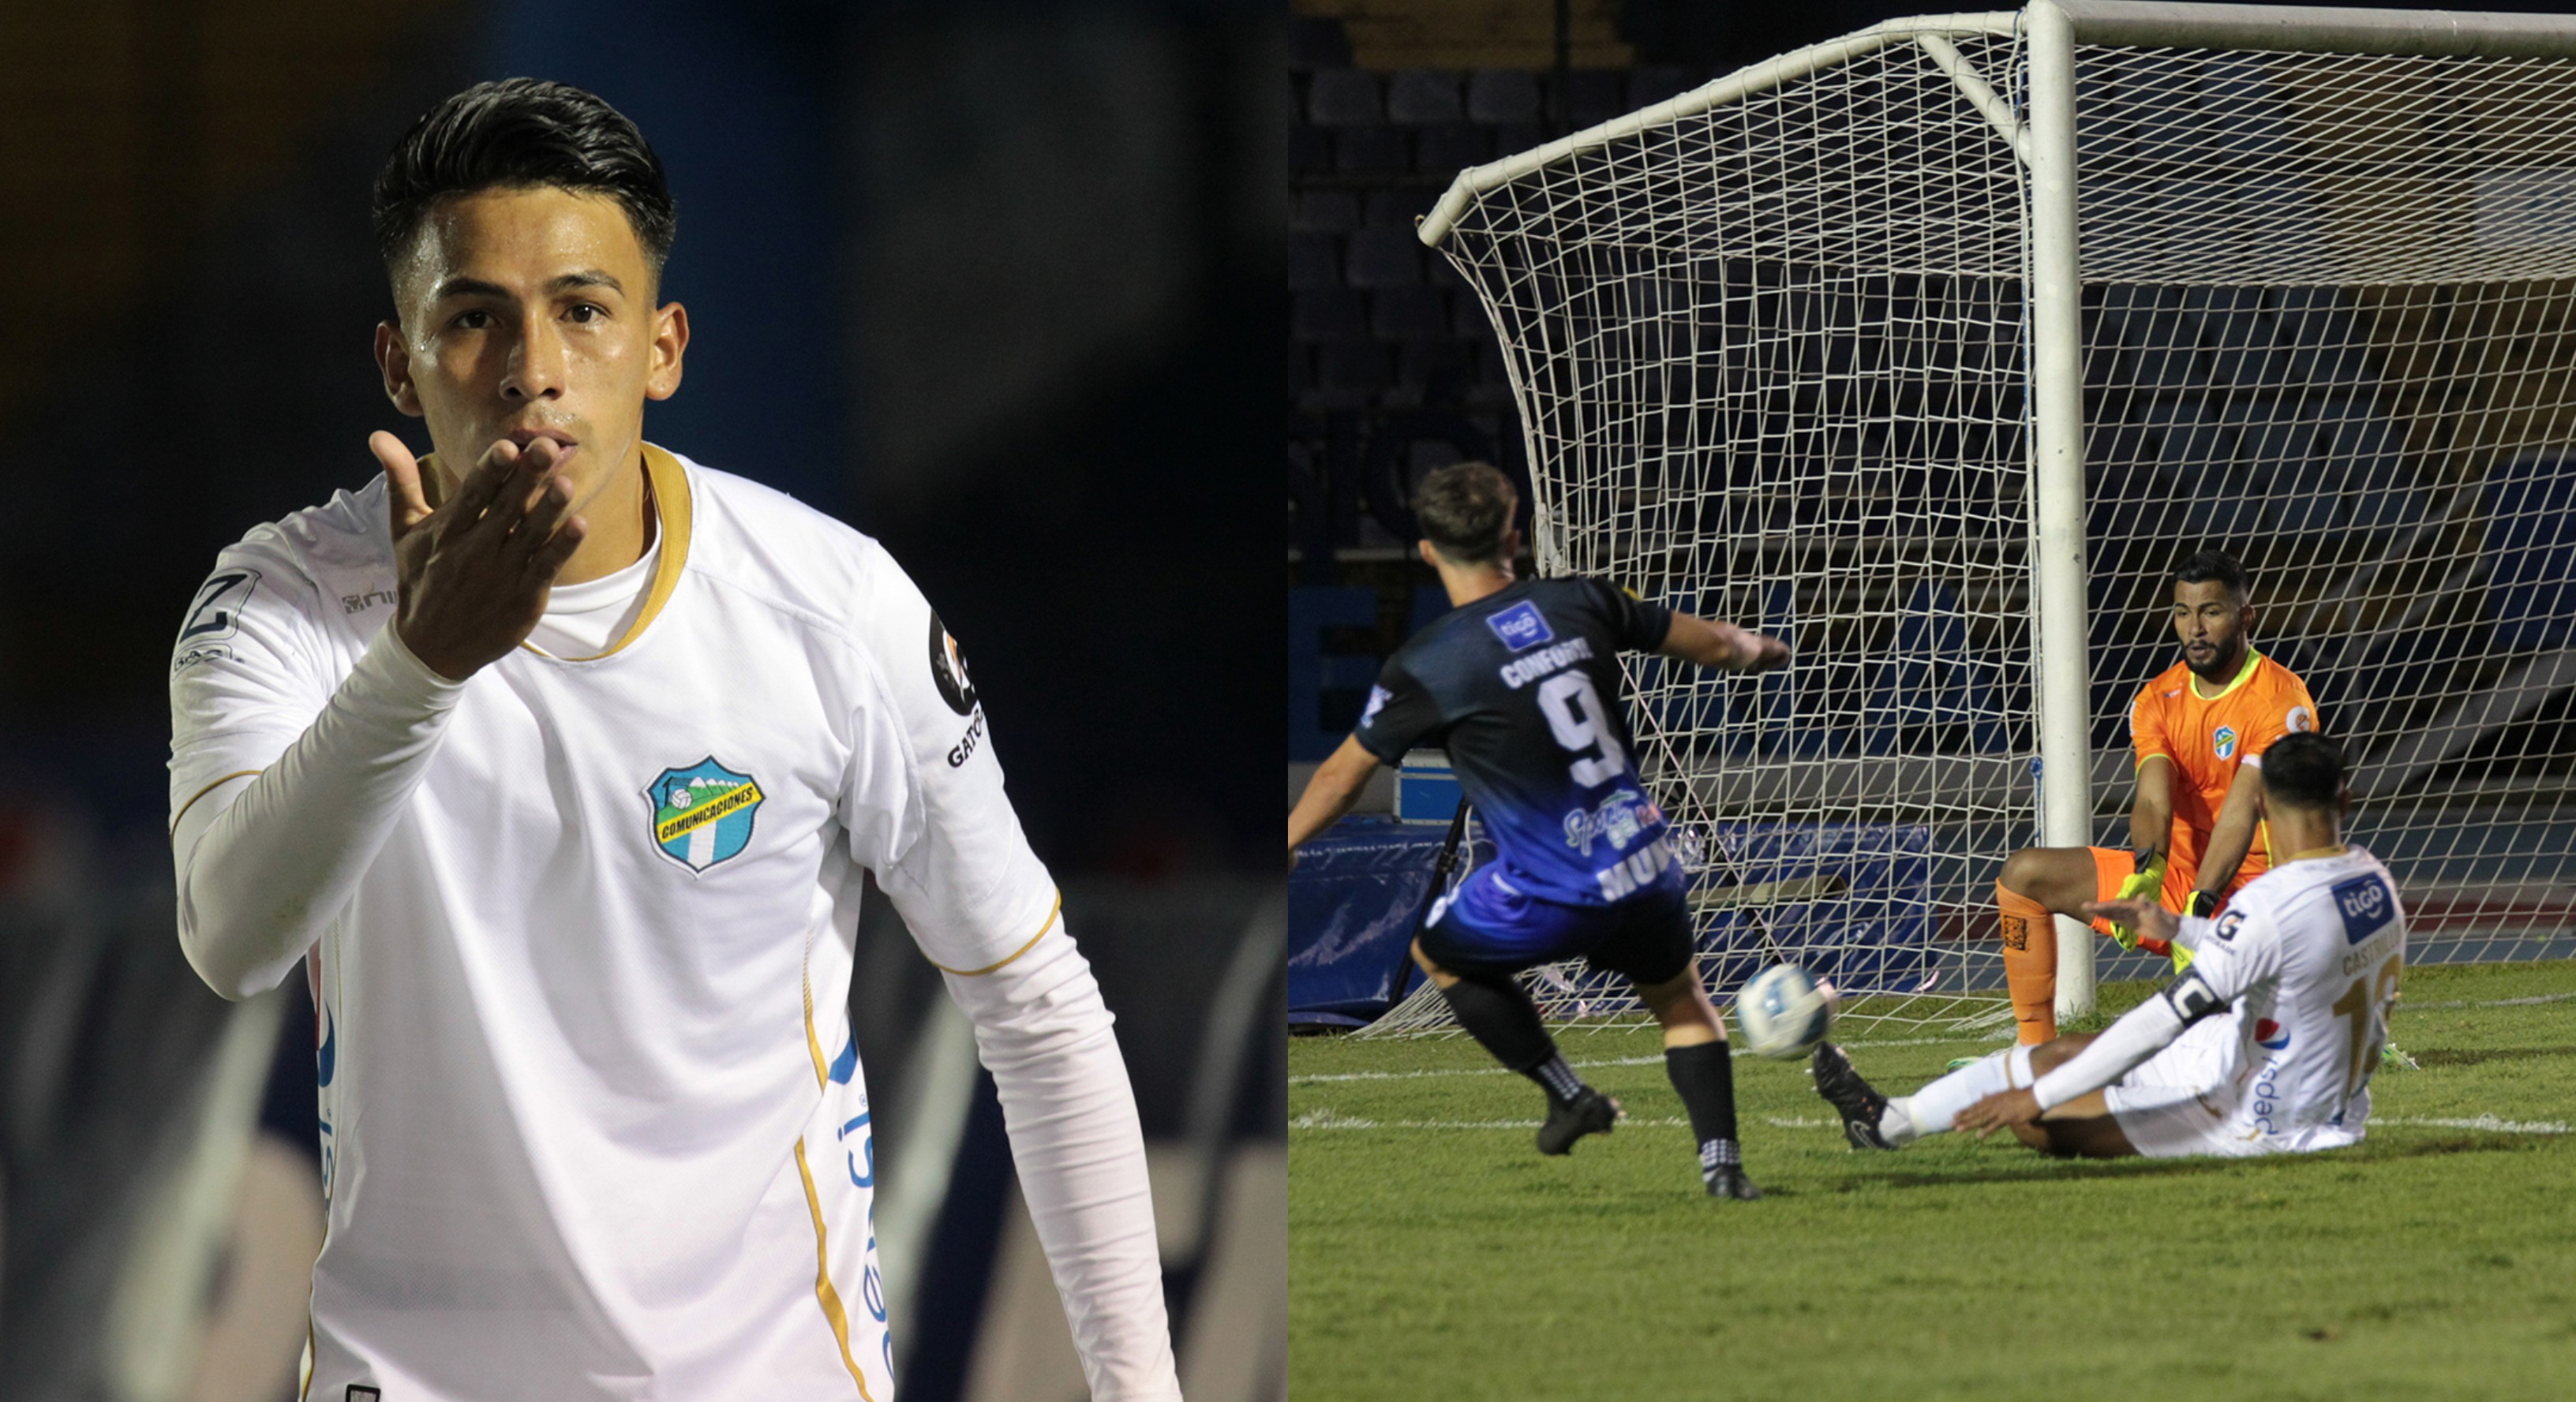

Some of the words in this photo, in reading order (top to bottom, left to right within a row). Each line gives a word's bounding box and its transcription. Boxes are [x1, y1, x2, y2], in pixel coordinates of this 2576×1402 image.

[1538, 669, 1625, 787] 9
[661, 786, 754, 839] COMUNICACIONES
[2343, 879, 2383, 918] tigo
[2174, 977, 2215, 1019] C
[2253, 1056, 2279, 1135] pepsi
